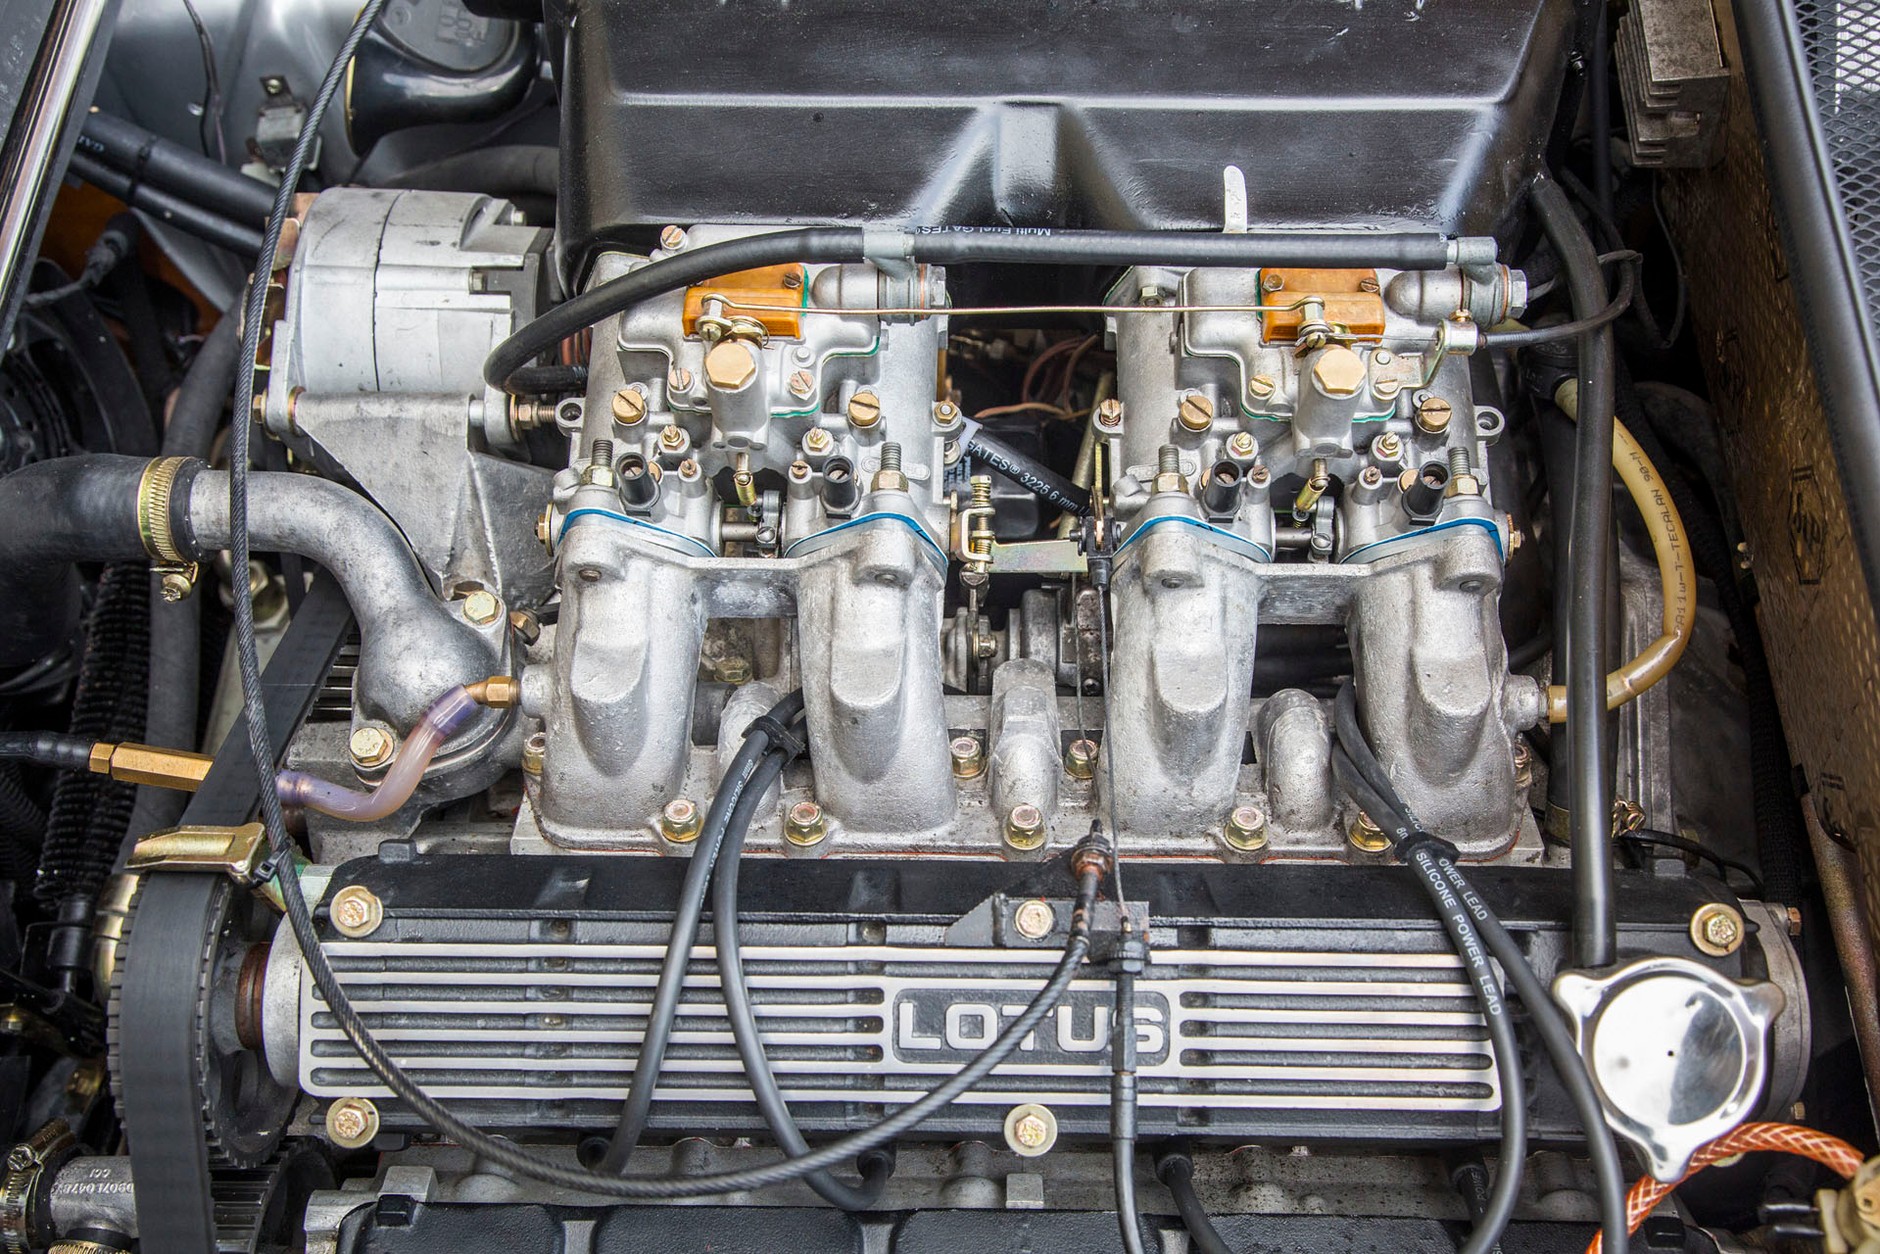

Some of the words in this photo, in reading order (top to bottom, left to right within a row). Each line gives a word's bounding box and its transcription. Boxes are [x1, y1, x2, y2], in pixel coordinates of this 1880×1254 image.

[1020, 472, 1051, 495] 3225
[1048, 490, 1060, 501] 6
[1058, 496, 1079, 512] mm
[1437, 856, 1467, 890] OWER
[1462, 890, 1489, 922] LEAD
[1415, 851, 1457, 910] SILICONE
[1452, 913, 1486, 969] POWER
[1479, 974, 1503, 1017] LEAD
